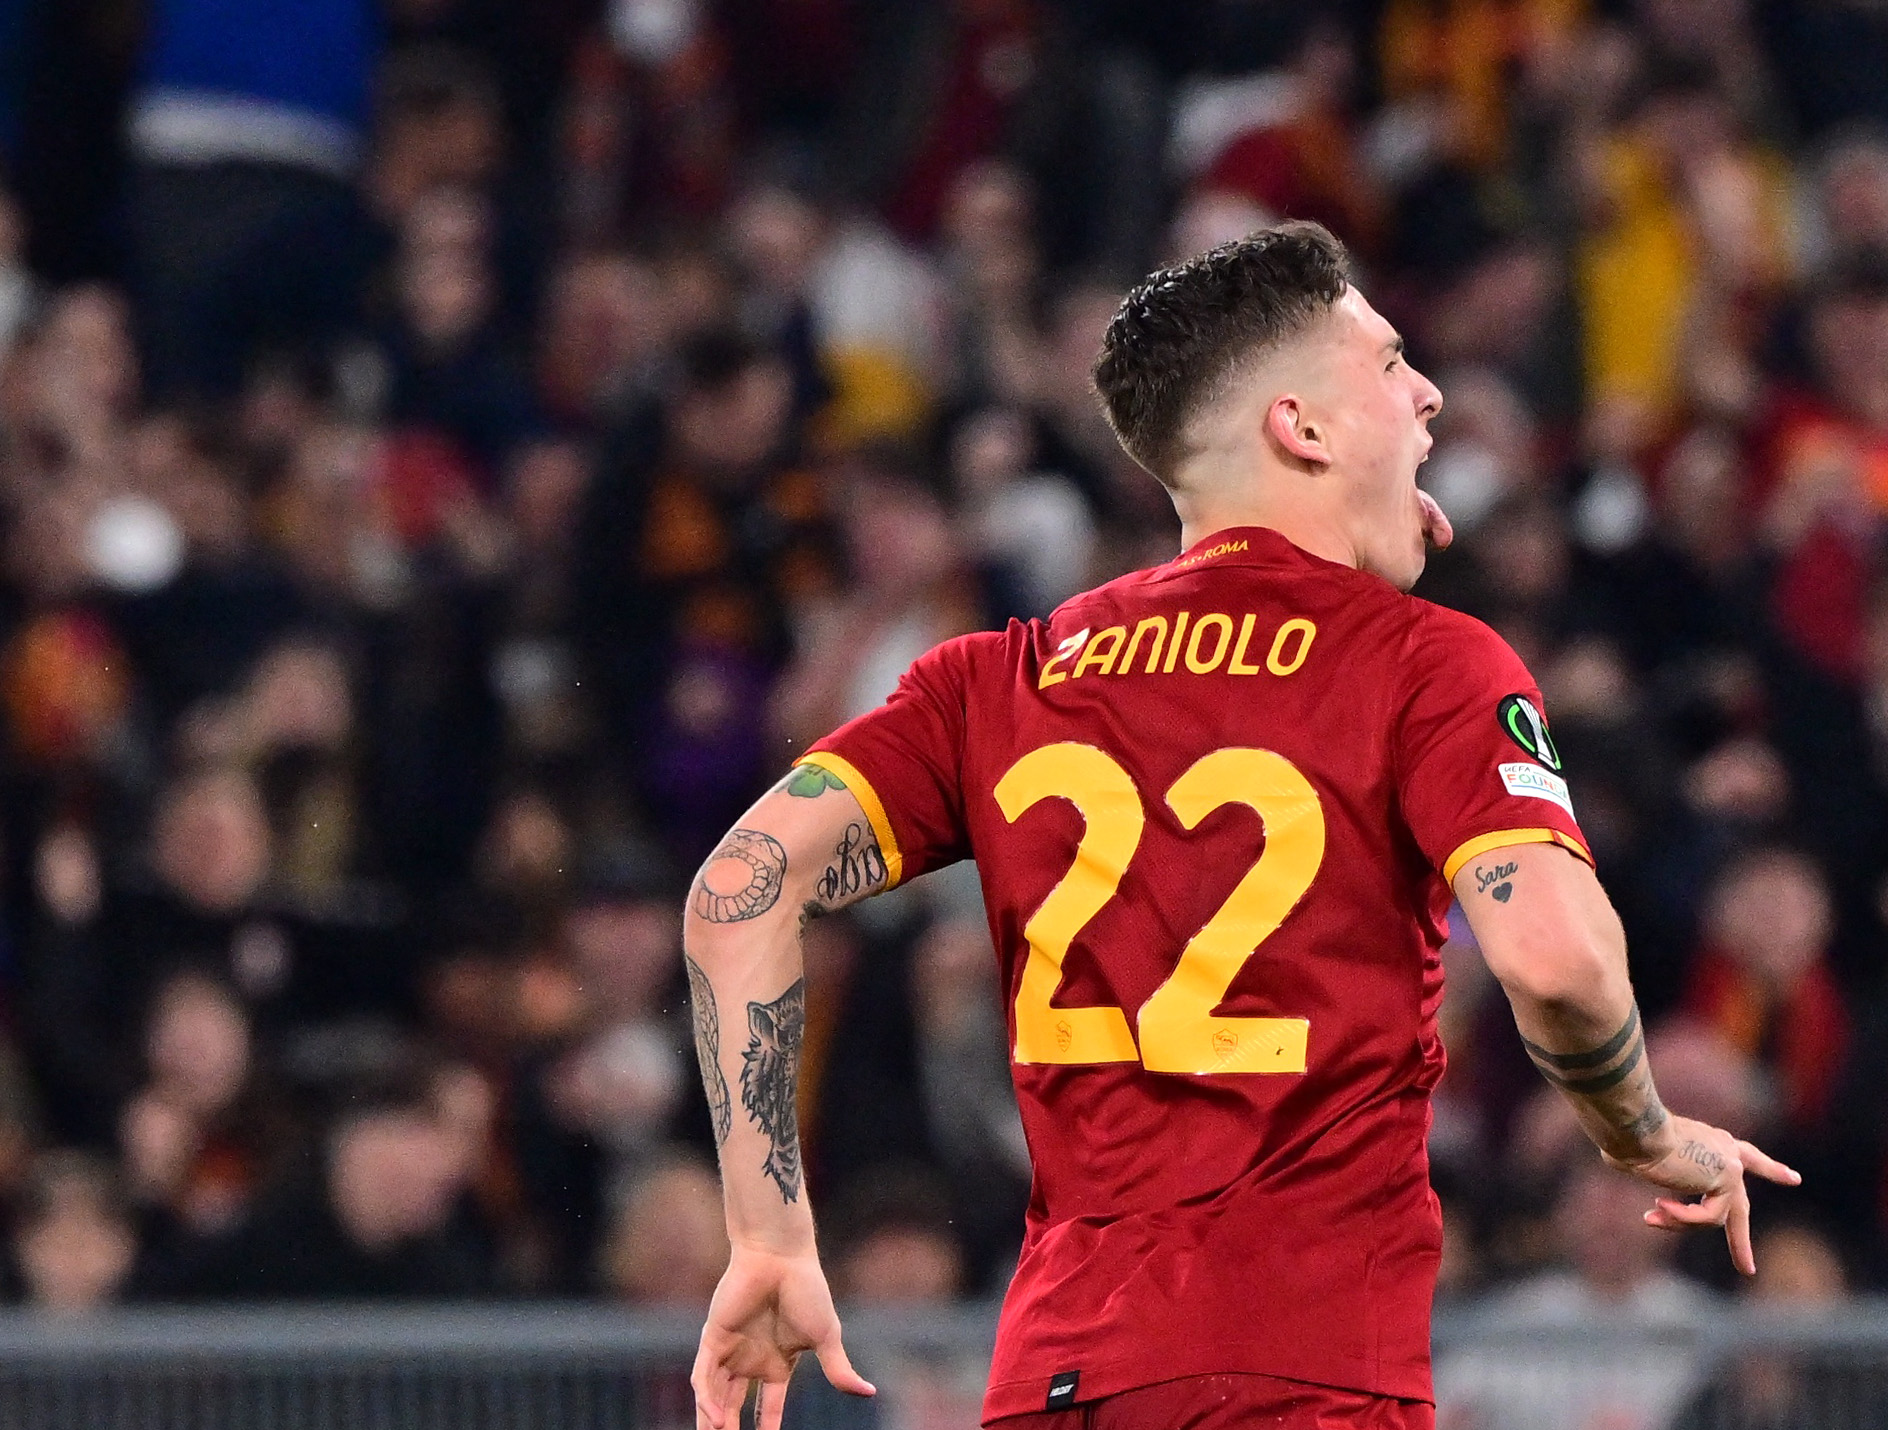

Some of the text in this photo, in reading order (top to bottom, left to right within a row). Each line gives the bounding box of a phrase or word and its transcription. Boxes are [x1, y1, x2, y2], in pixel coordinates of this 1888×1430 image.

[1038, 611, 1317, 690] ZANIOLO
[1504, 765, 1531, 773] UEFA
[1475, 862, 1518, 893] Sara
[993, 740, 1326, 1074] 22
